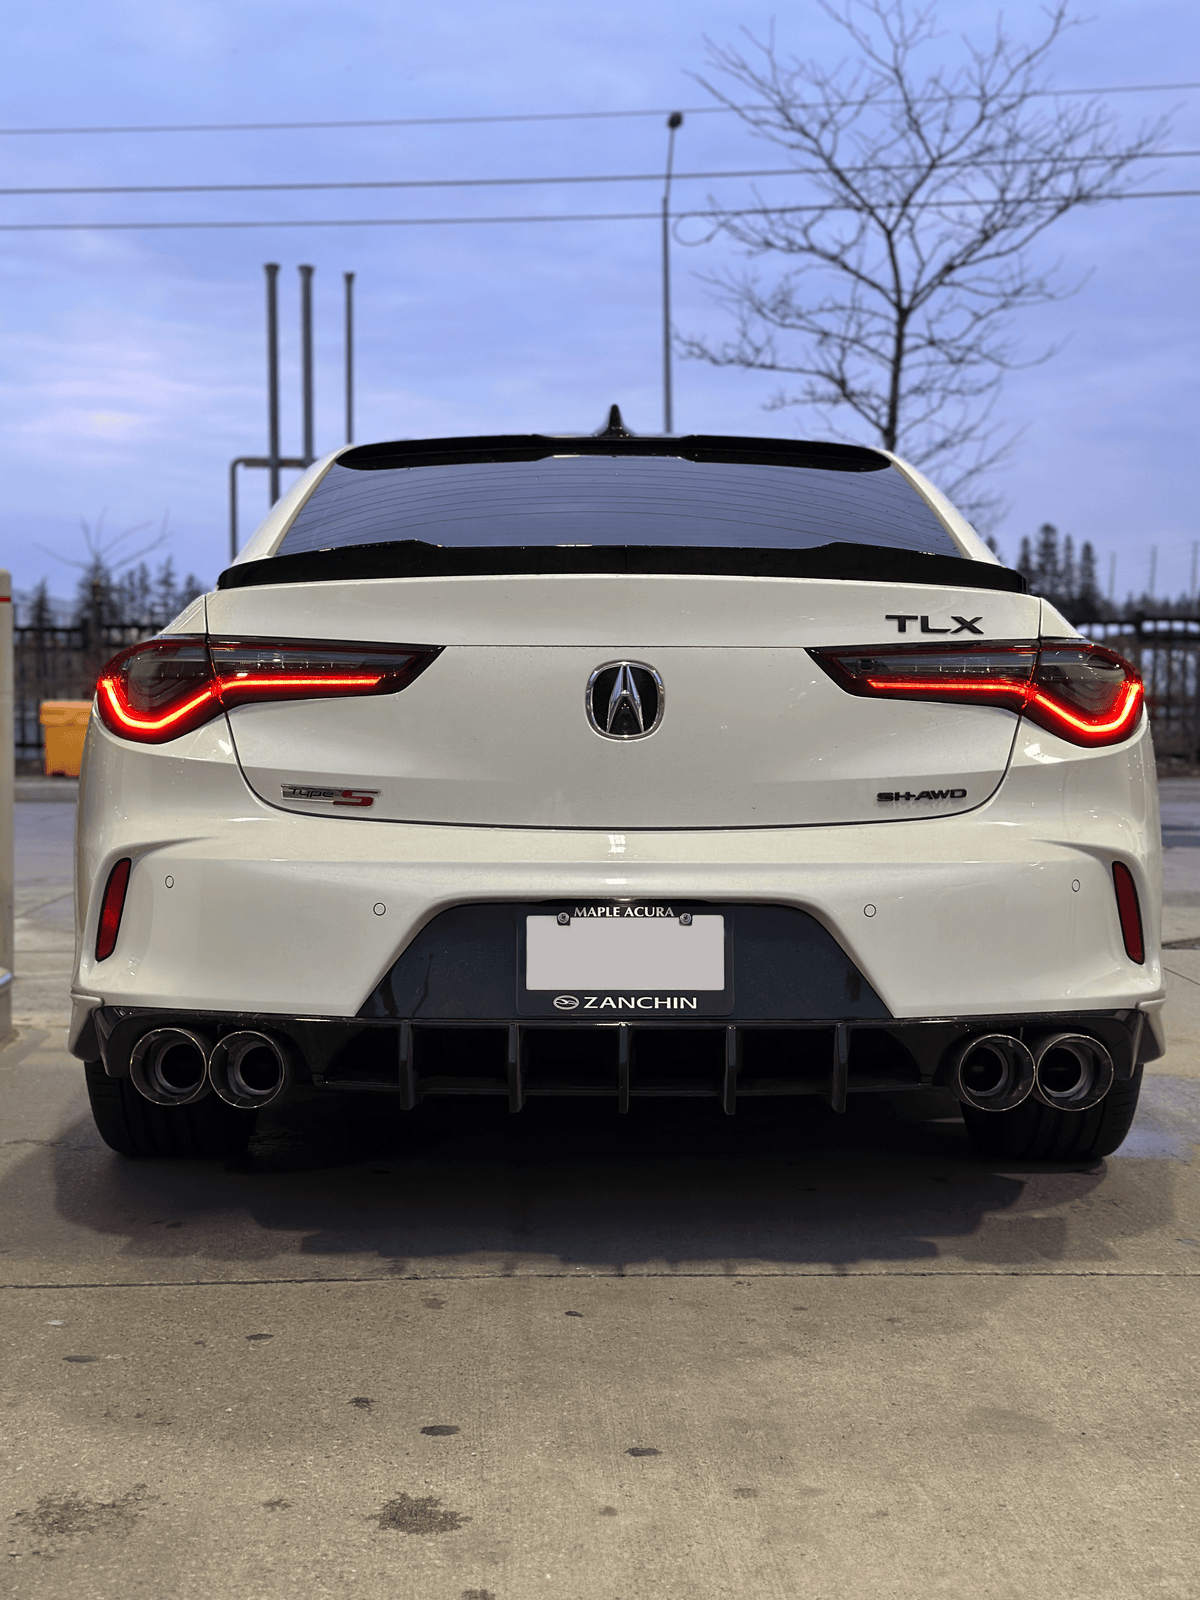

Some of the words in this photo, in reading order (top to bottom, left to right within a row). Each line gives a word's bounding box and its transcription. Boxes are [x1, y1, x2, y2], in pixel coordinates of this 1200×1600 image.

[885, 614, 984, 635] TLX
[289, 786, 335, 799] Type
[332, 789, 379, 807] S
[876, 788, 968, 802] SH-AWD
[573, 906, 621, 918] MAPLE
[623, 906, 675, 918] ACURA
[583, 996, 698, 1010] ZANCHIN
